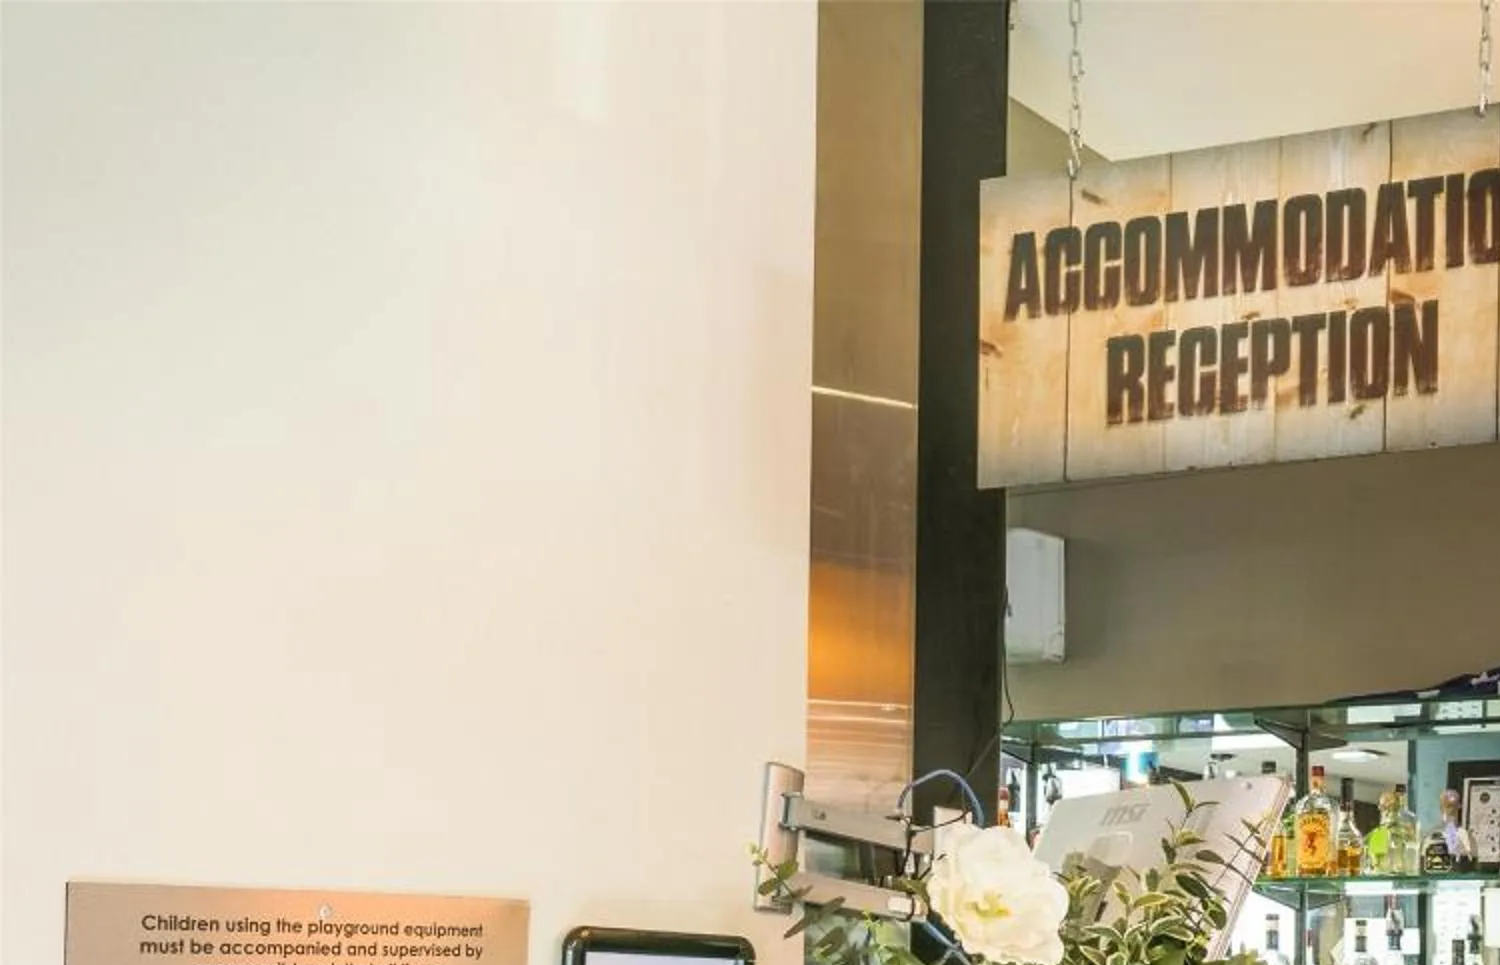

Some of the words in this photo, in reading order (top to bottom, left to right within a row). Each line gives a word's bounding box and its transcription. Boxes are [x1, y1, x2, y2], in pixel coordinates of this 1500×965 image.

[1106, 300, 1439, 428] RECEPTION
[141, 914, 220, 933] Children
[225, 916, 272, 937] using
[276, 917, 303, 934] the
[307, 919, 400, 939] playground
[403, 922, 483, 940] equipment
[139, 937, 185, 955] must
[189, 937, 216, 955] be
[218, 940, 343, 959] accompanied
[345, 941, 378, 958] and
[381, 942, 462, 961] supervised
[464, 943, 483, 961] by
